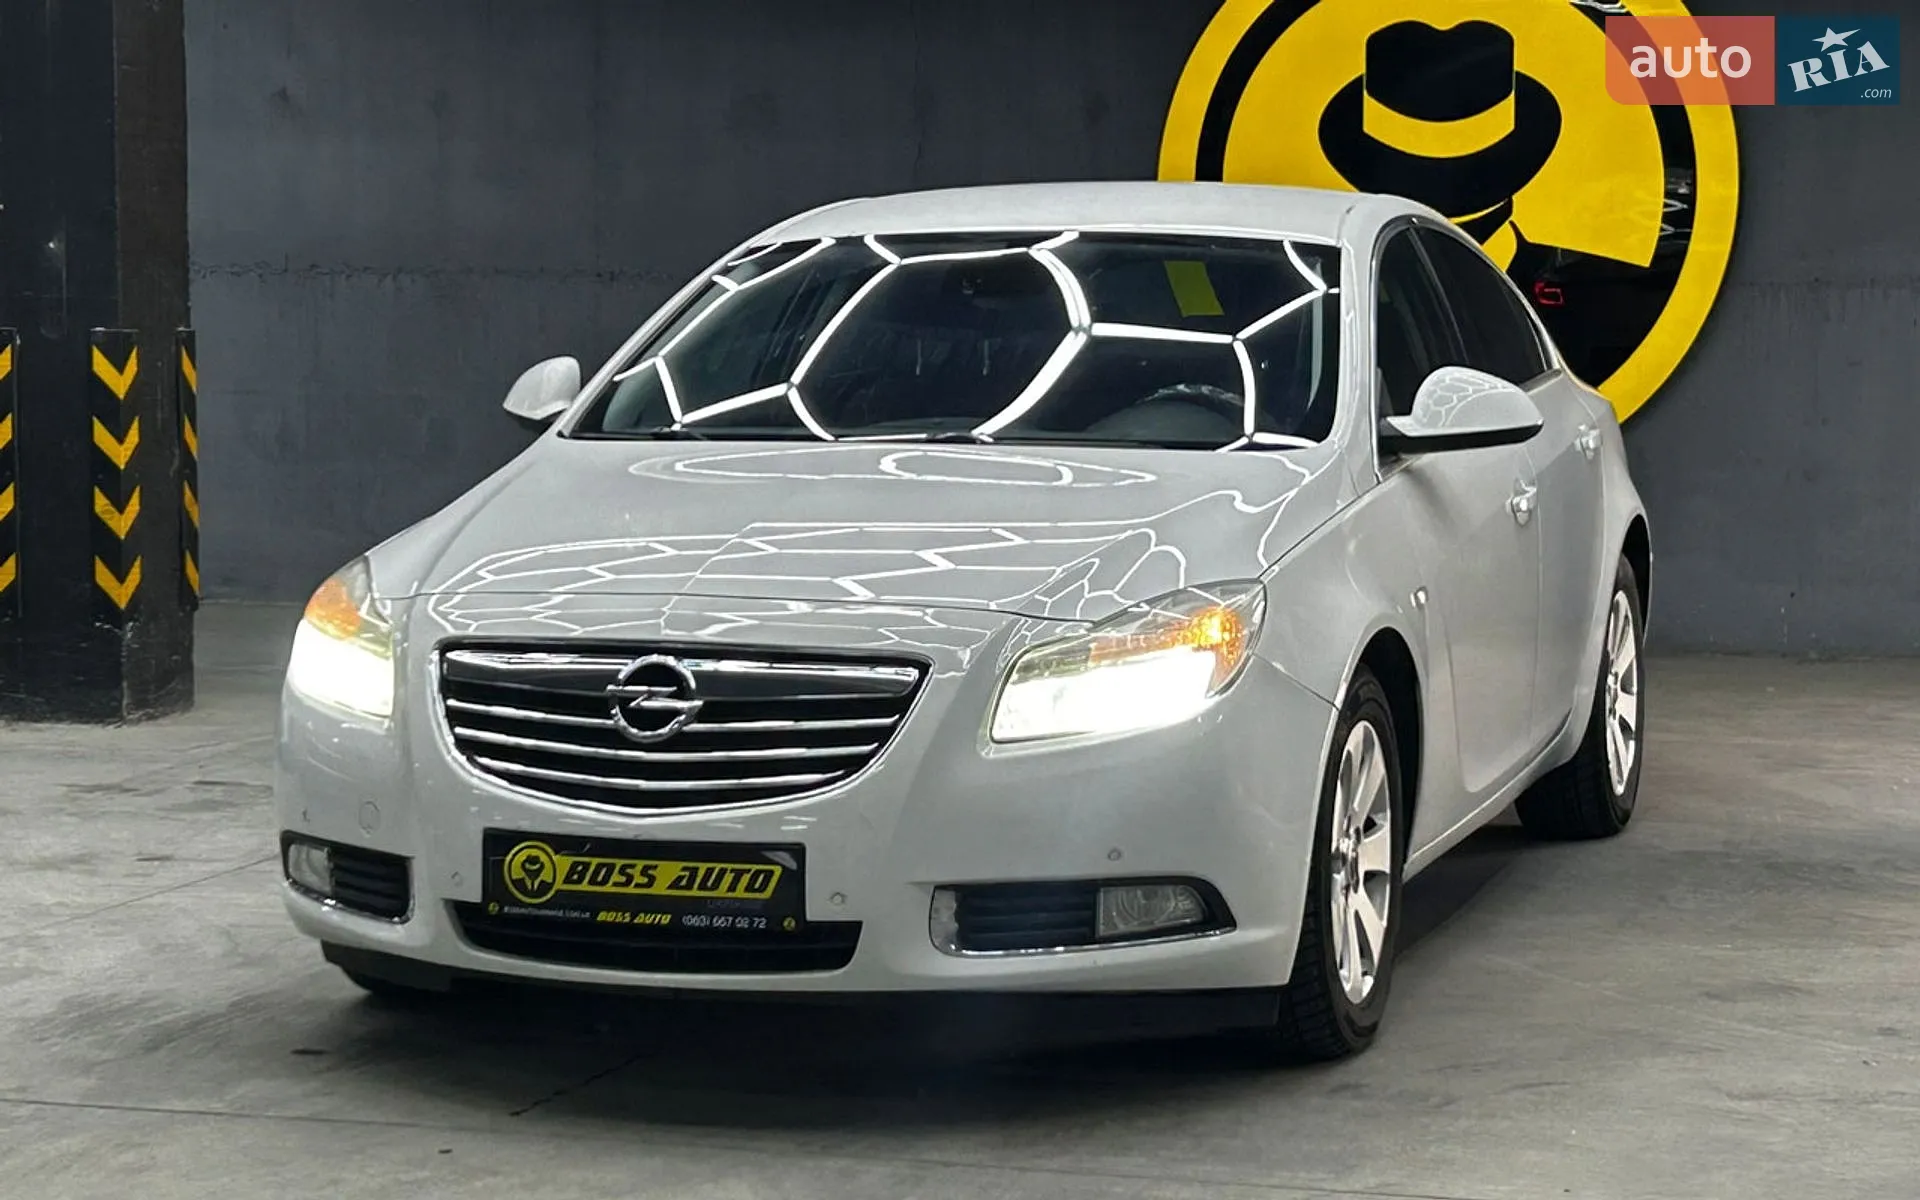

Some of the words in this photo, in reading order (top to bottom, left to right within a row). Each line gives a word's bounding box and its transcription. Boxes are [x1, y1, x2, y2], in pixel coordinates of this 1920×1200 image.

[563, 861, 657, 889] BOSS
[666, 866, 777, 894] AUTO
[597, 911, 631, 923] BOSS
[634, 912, 672, 925] AUTO
[753, 917, 768, 929] 72
